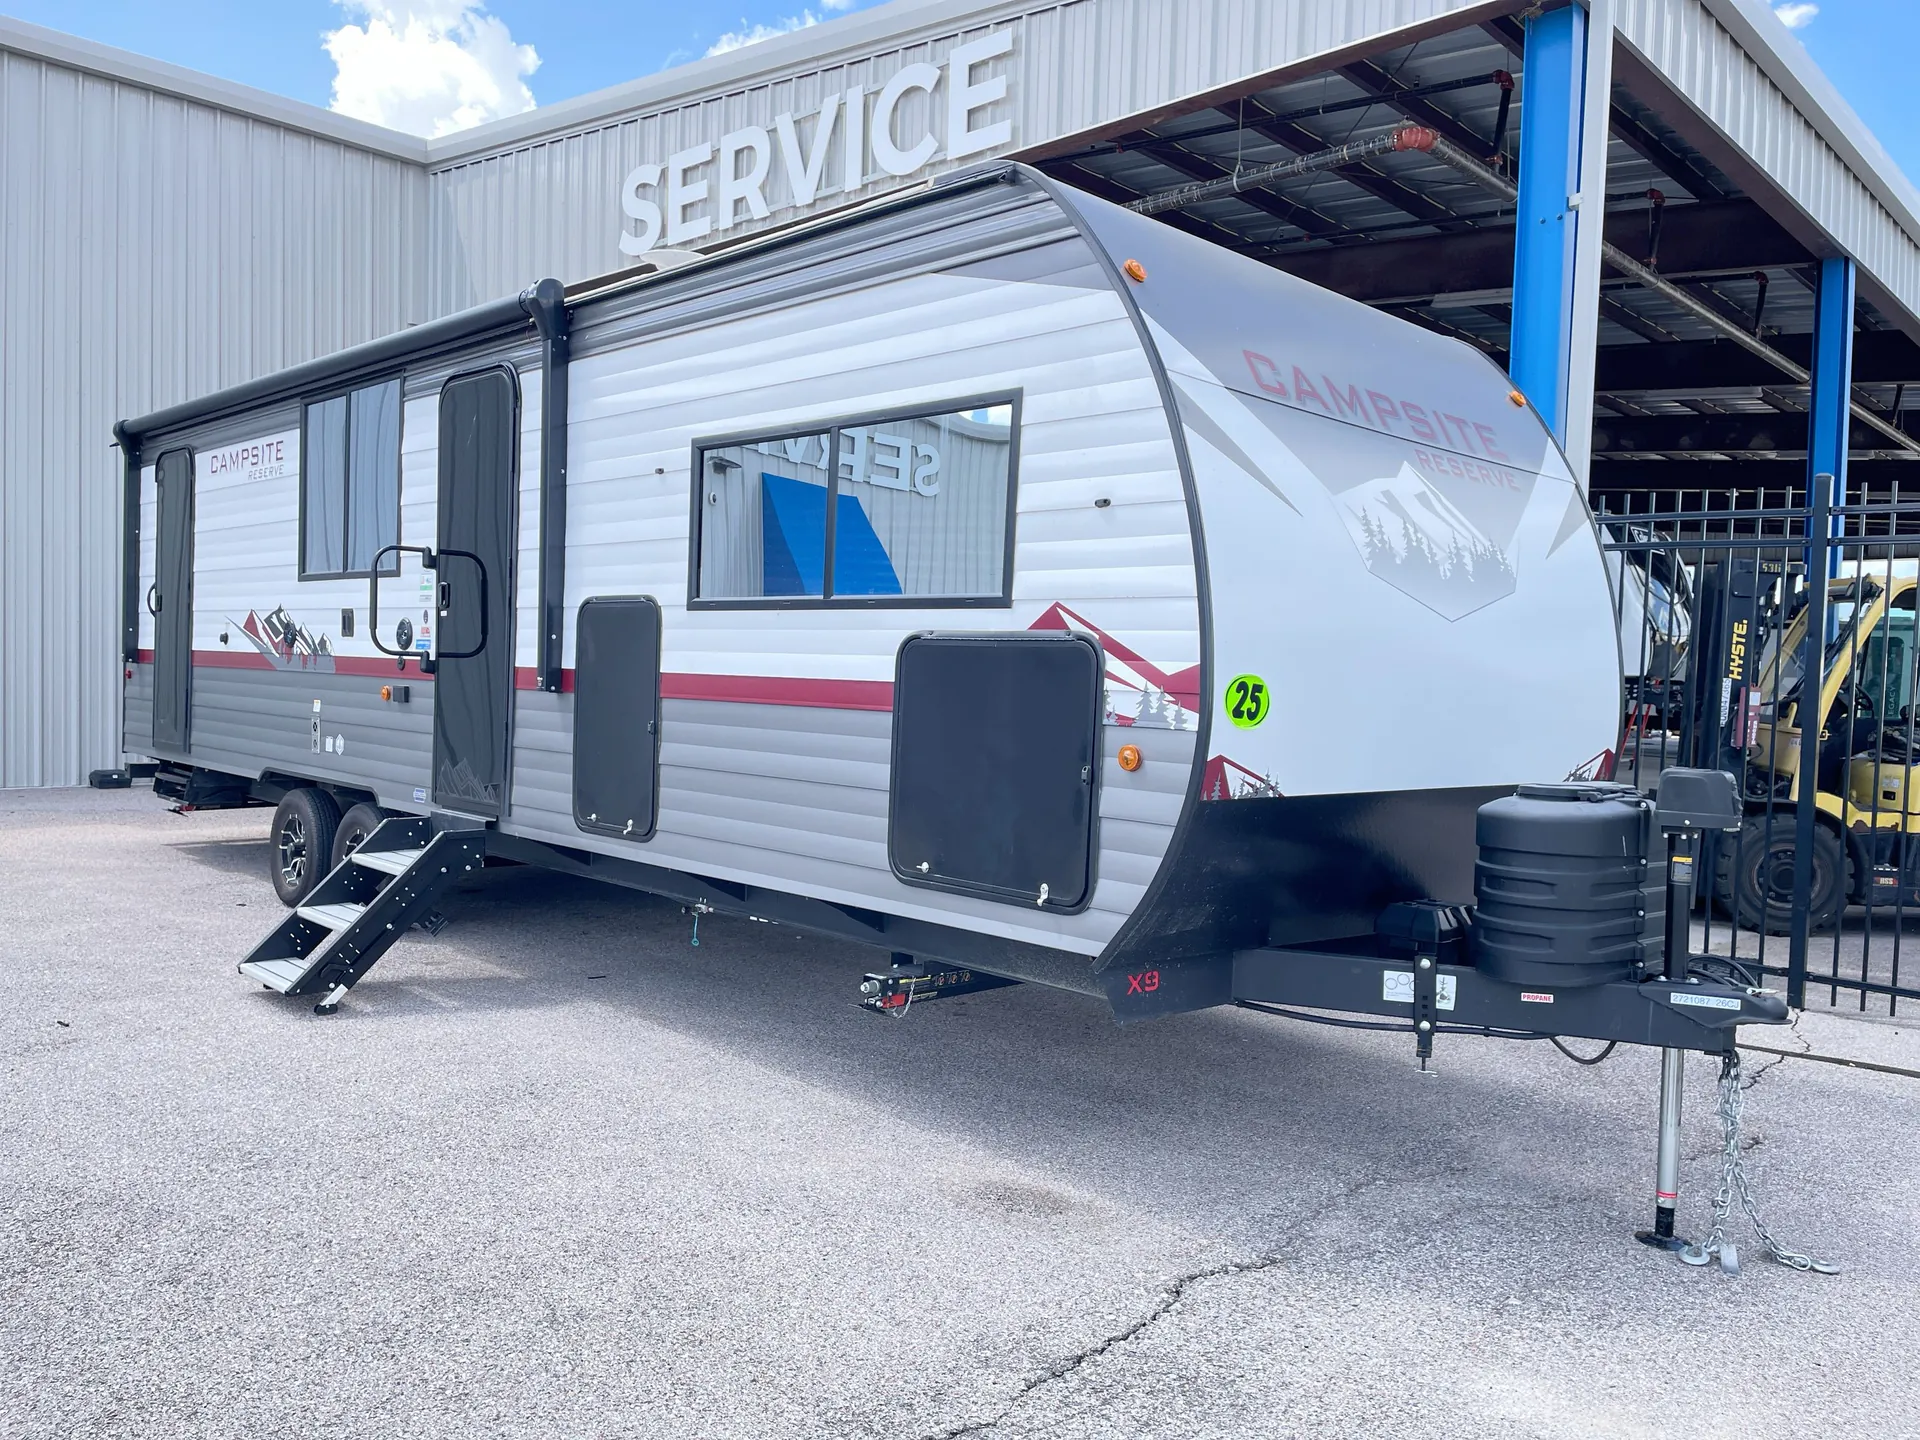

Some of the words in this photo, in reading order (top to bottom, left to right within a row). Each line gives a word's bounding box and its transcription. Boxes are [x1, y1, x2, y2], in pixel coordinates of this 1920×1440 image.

[619, 27, 1013, 256] SERVICE
[1243, 349, 1510, 461] CAMPSITE
[210, 440, 284, 474] CAMPSITE
[248, 464, 284, 480] RESERVE
[1414, 448, 1521, 492] RESERVE
[1232, 681, 1263, 721] 25
[1887, 686, 1896, 716] EGACY
[1127, 970, 1160, 995] X9
[1522, 993, 1551, 1002] PROPANE
[1672, 994, 1711, 1005] 2721087
[1716, 998, 1739, 1009] 26CJ
